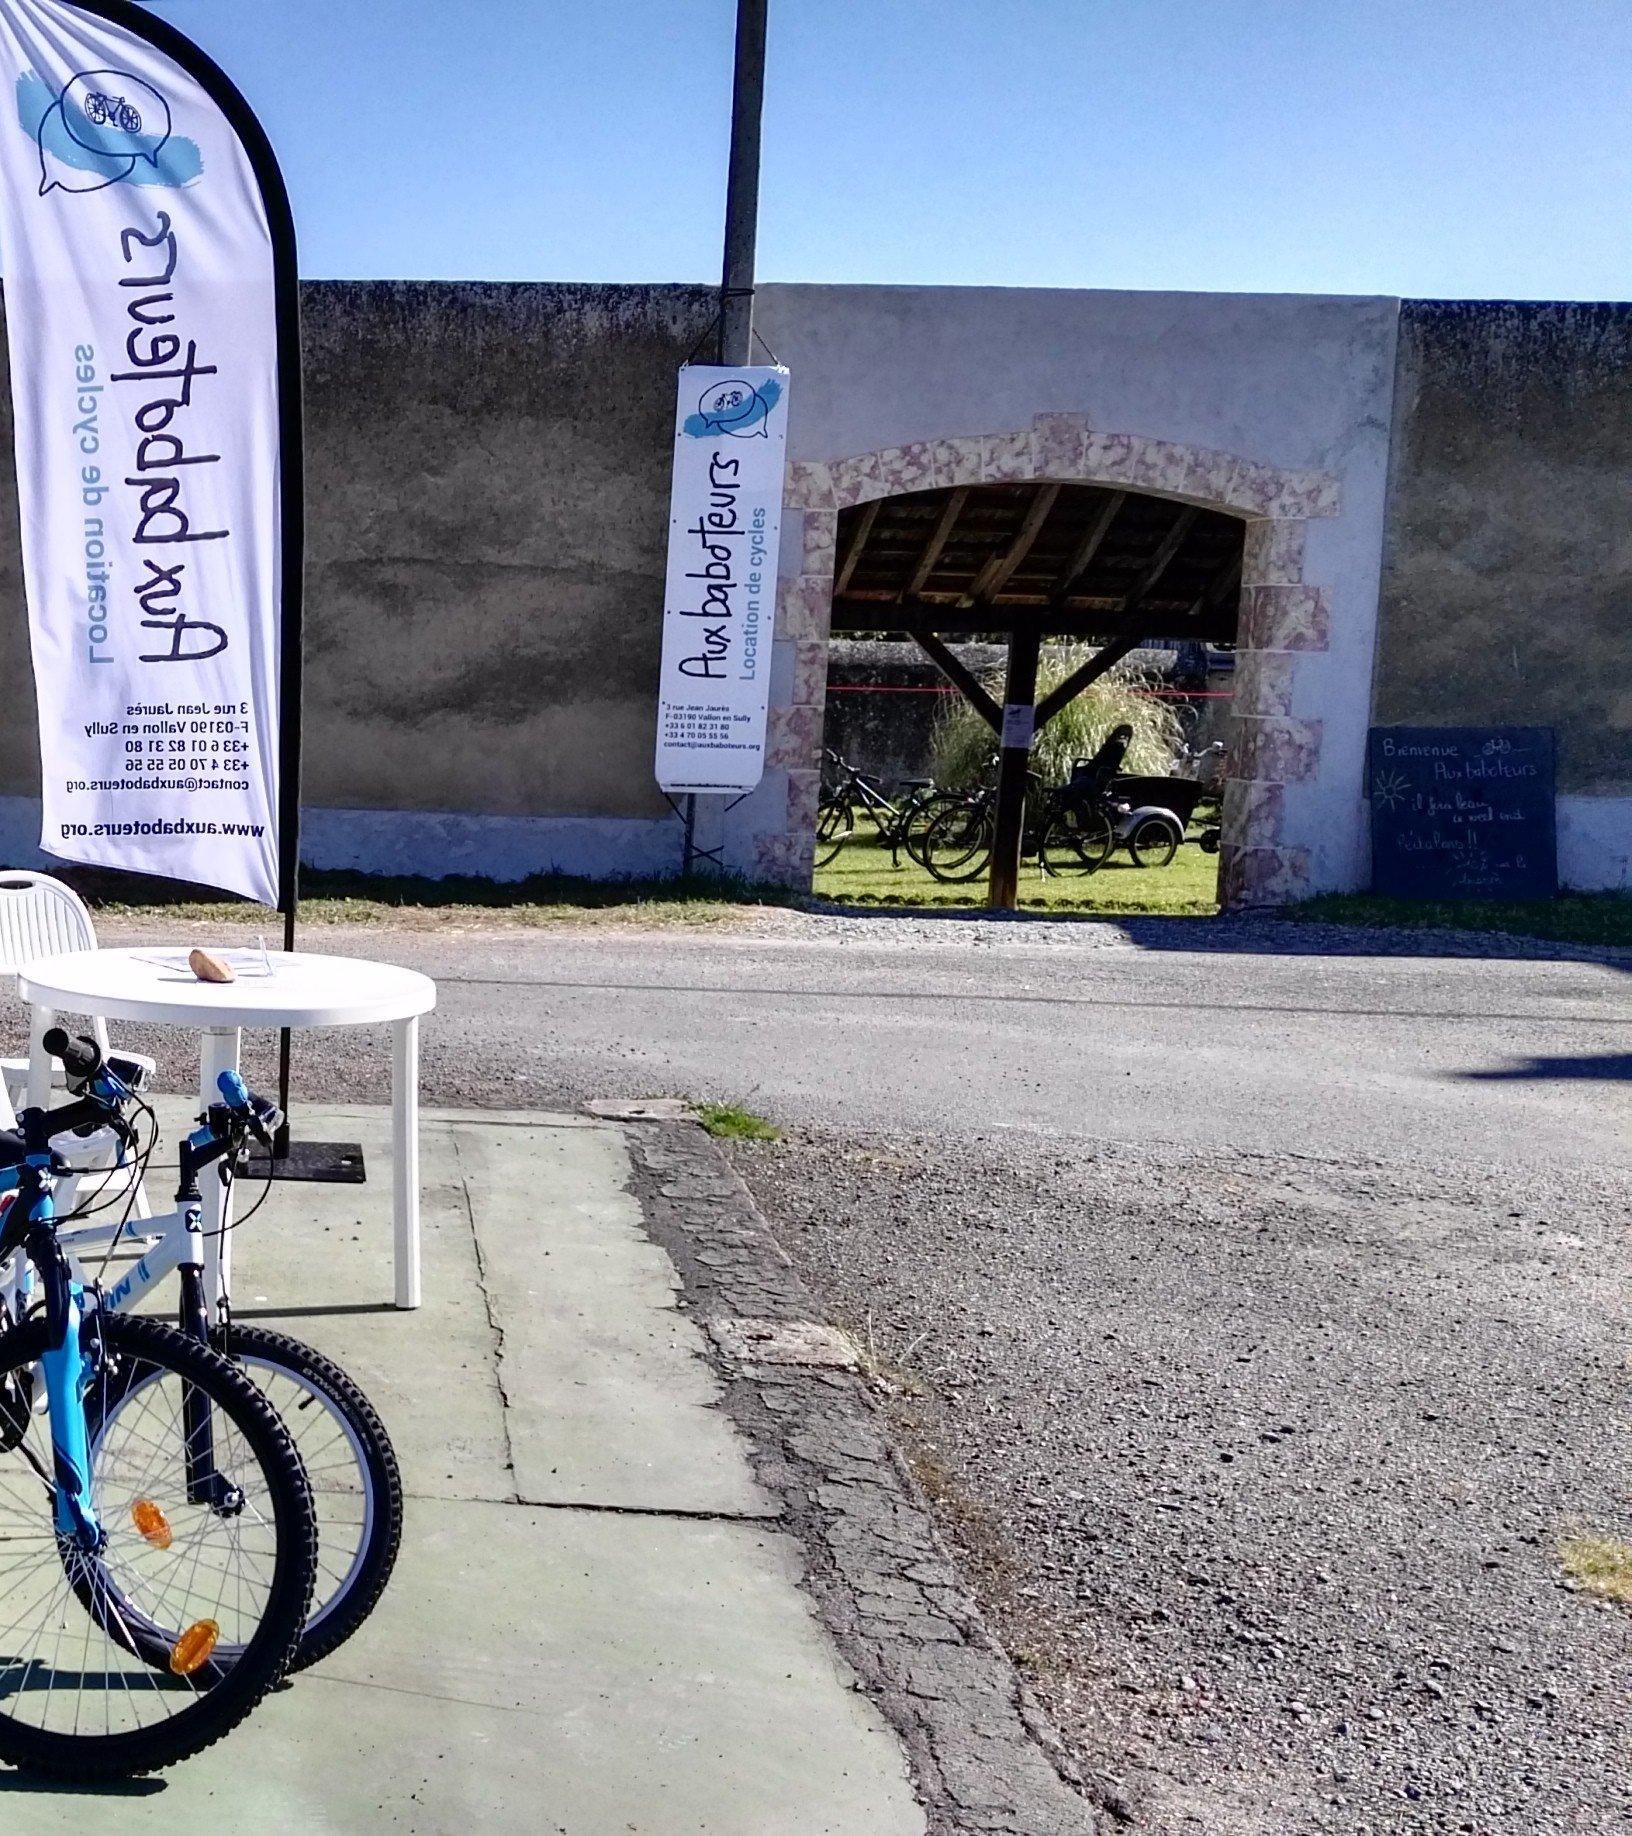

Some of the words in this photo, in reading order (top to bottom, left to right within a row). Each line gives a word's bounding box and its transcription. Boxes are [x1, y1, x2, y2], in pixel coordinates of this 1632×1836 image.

[679, 452, 745, 617] baboteurs
[748, 507, 767, 566] cycles
[744, 572, 761, 594] de
[678, 624, 731, 678] Aux
[740, 604, 759, 680] Location
[734, 715, 751, 723] Sully
[1383, 738, 1459, 757] Bienvenue
